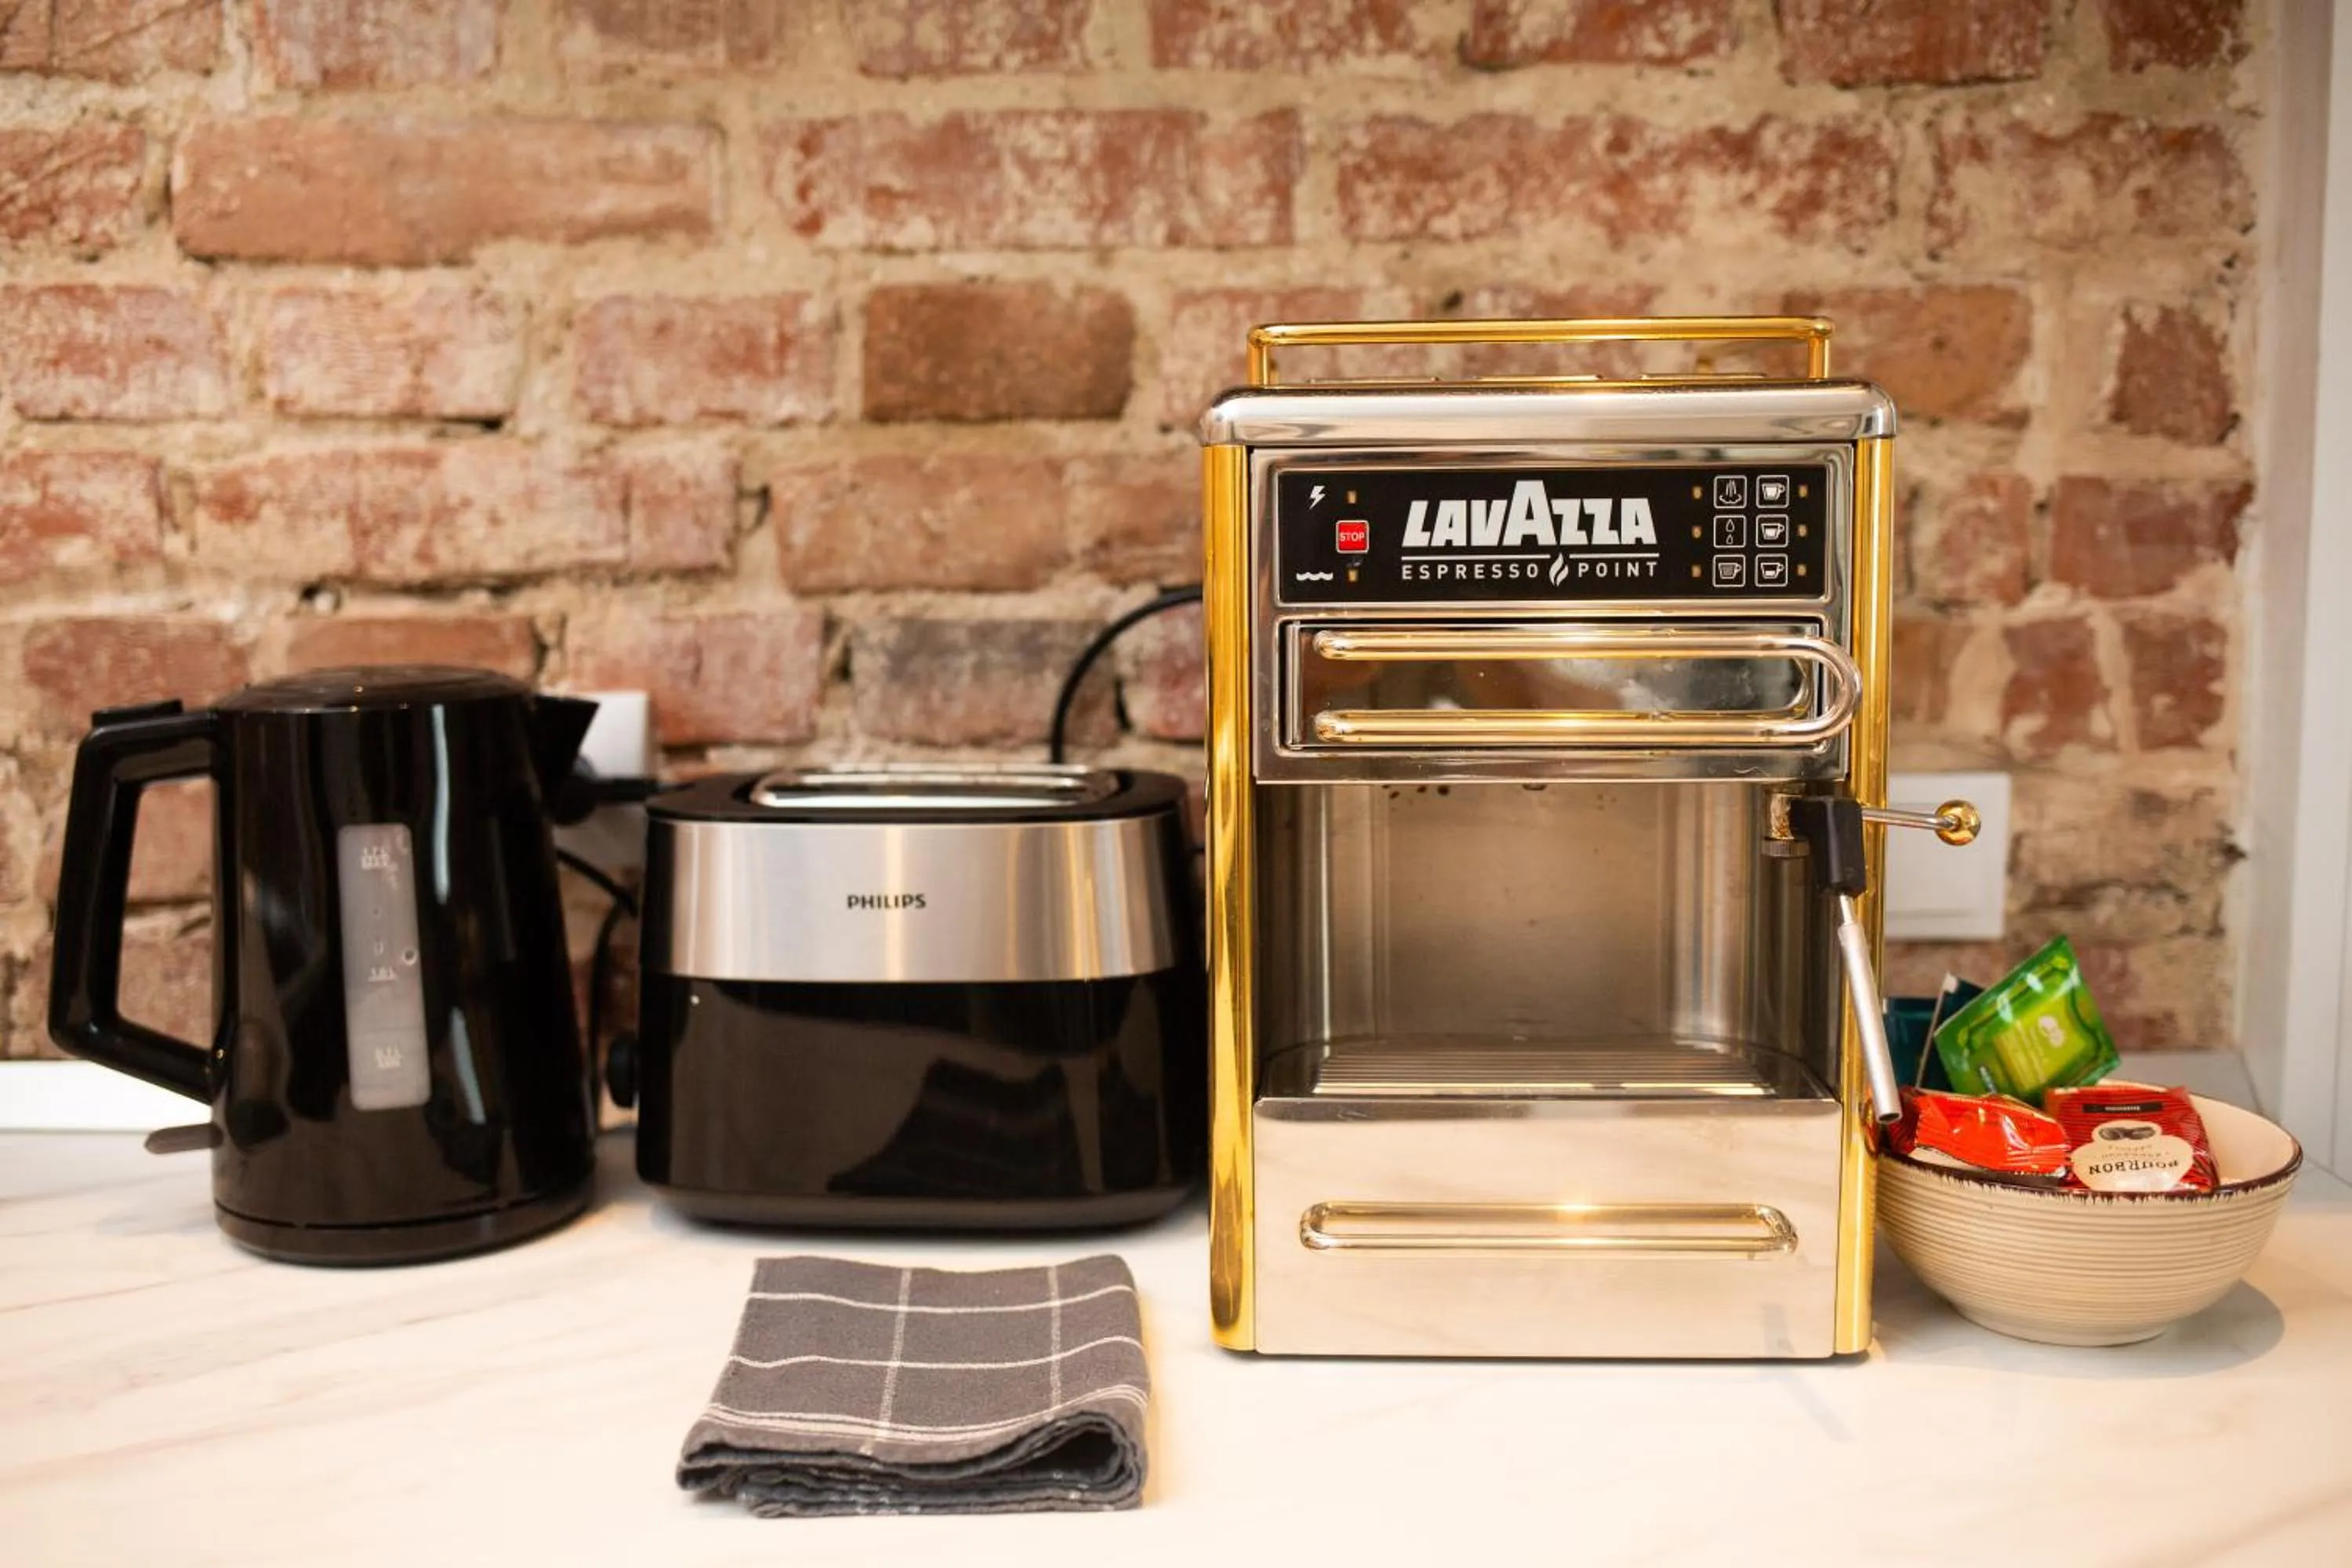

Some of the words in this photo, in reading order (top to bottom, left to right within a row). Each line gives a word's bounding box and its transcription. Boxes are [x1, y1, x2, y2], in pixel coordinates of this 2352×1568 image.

[1402, 480, 1657, 547] LAVAZZA
[1340, 532, 1365, 542] STOP
[1402, 564, 1539, 580] ESPRESSO
[1579, 562, 1657, 578] POINT
[847, 894, 927, 909] PHILIPS
[2089, 1160, 2179, 1175] BOURBON
